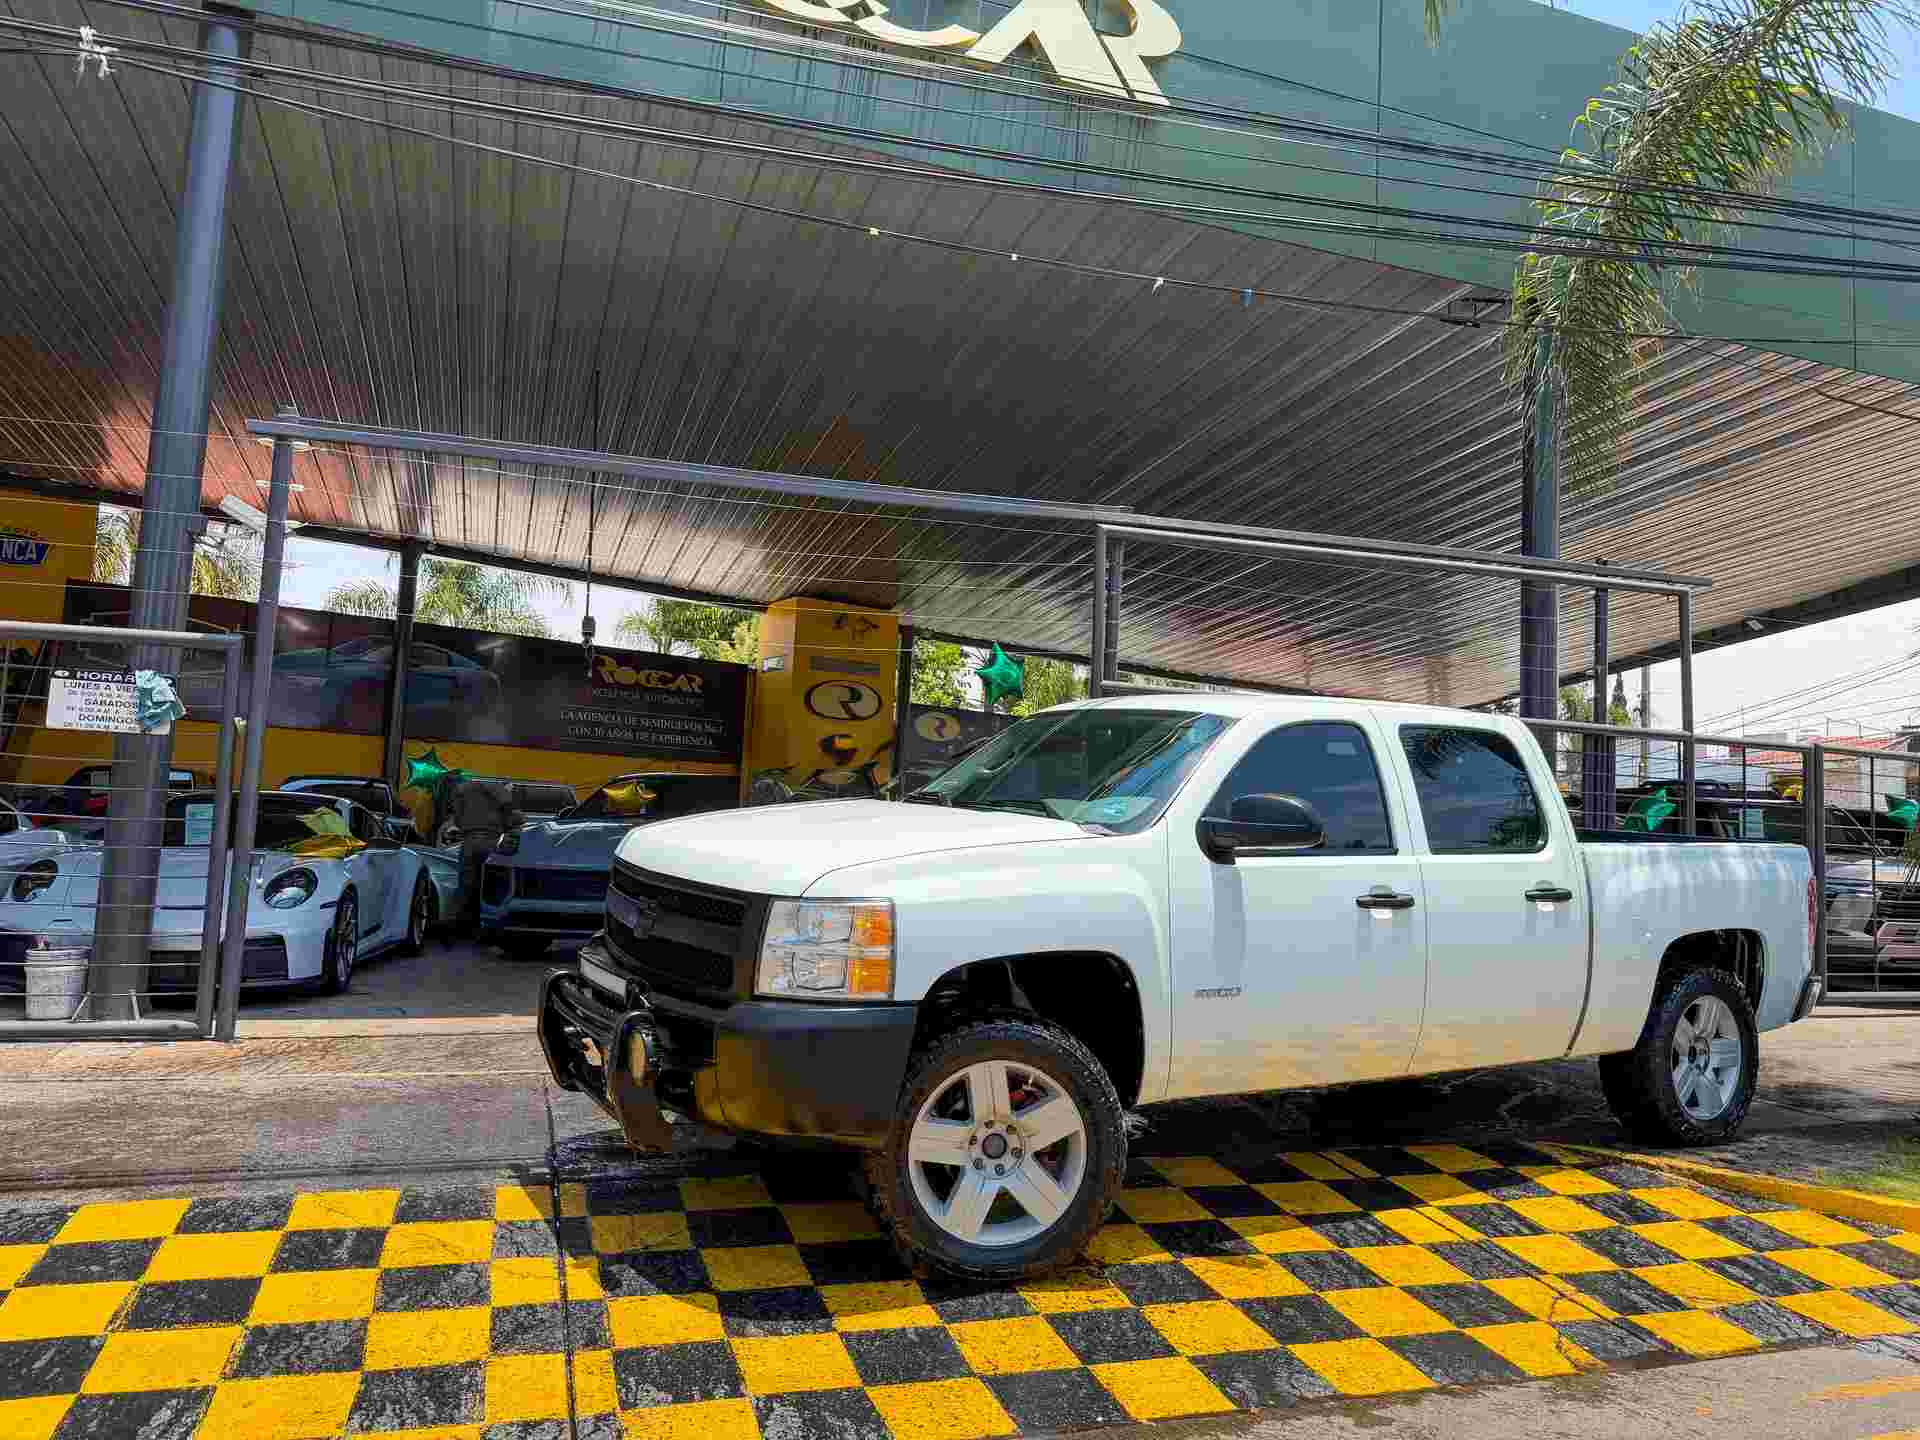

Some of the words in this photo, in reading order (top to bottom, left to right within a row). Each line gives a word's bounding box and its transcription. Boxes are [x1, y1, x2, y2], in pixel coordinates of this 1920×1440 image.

[0, 542, 37, 561] NCA
[64, 680, 101, 691] LUNES
[103, 682, 113, 692] A
